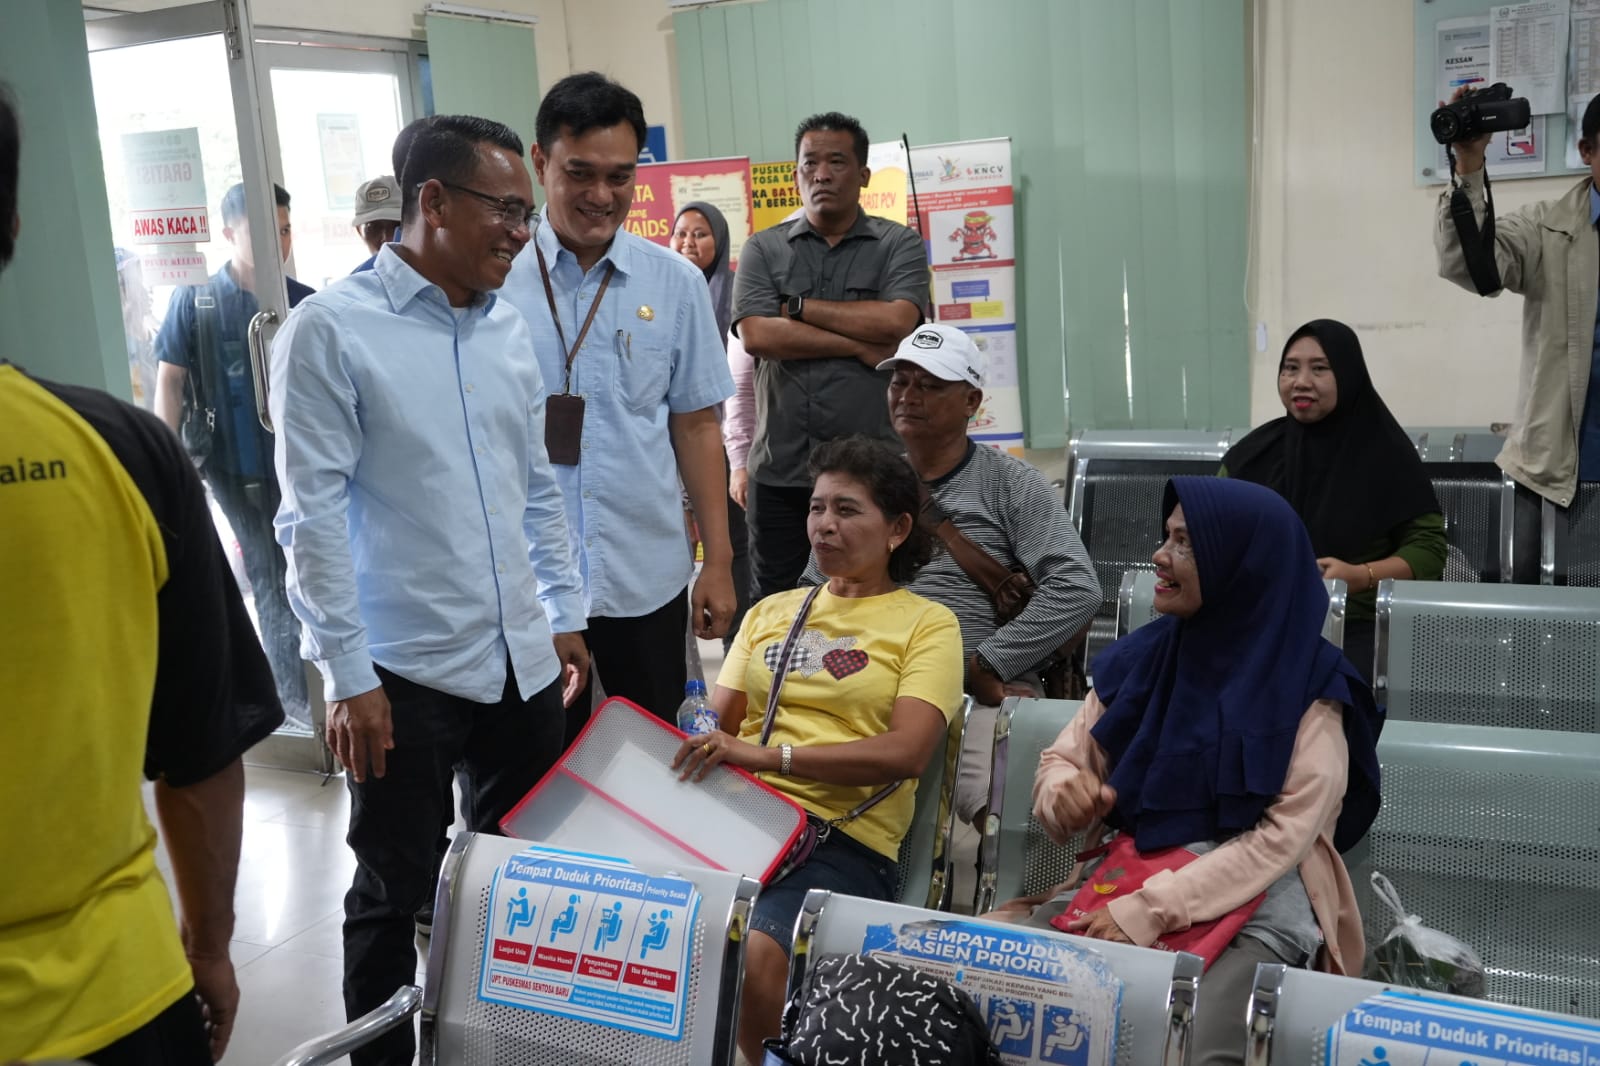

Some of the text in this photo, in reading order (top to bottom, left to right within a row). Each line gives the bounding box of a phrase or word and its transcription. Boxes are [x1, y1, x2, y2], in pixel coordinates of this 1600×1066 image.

[752, 164, 796, 175] PUSKES
[974, 165, 1004, 175] KNCV
[752, 175, 779, 185] TOSA
[632, 184, 655, 203] TA
[752, 189, 767, 198] KA
[134, 217, 165, 236] AWAS
[166, 216, 198, 235] KACA
[625, 217, 670, 238] /AIDS
[0, 457, 66, 484] aian
[509, 860, 552, 880] Tempat
[553, 867, 592, 885] Duduk
[592, 874, 644, 893] Prioritas
[647, 886, 668, 898] Priority
[922, 928, 998, 949] EMPAT
[502, 976, 532, 990] PUSKESMAS
[532, 982, 555, 994] SENTOSA
[555, 986, 570, 998] BARU
[1351, 1008, 1582, 1065] Tempat Duduk Prioritas
